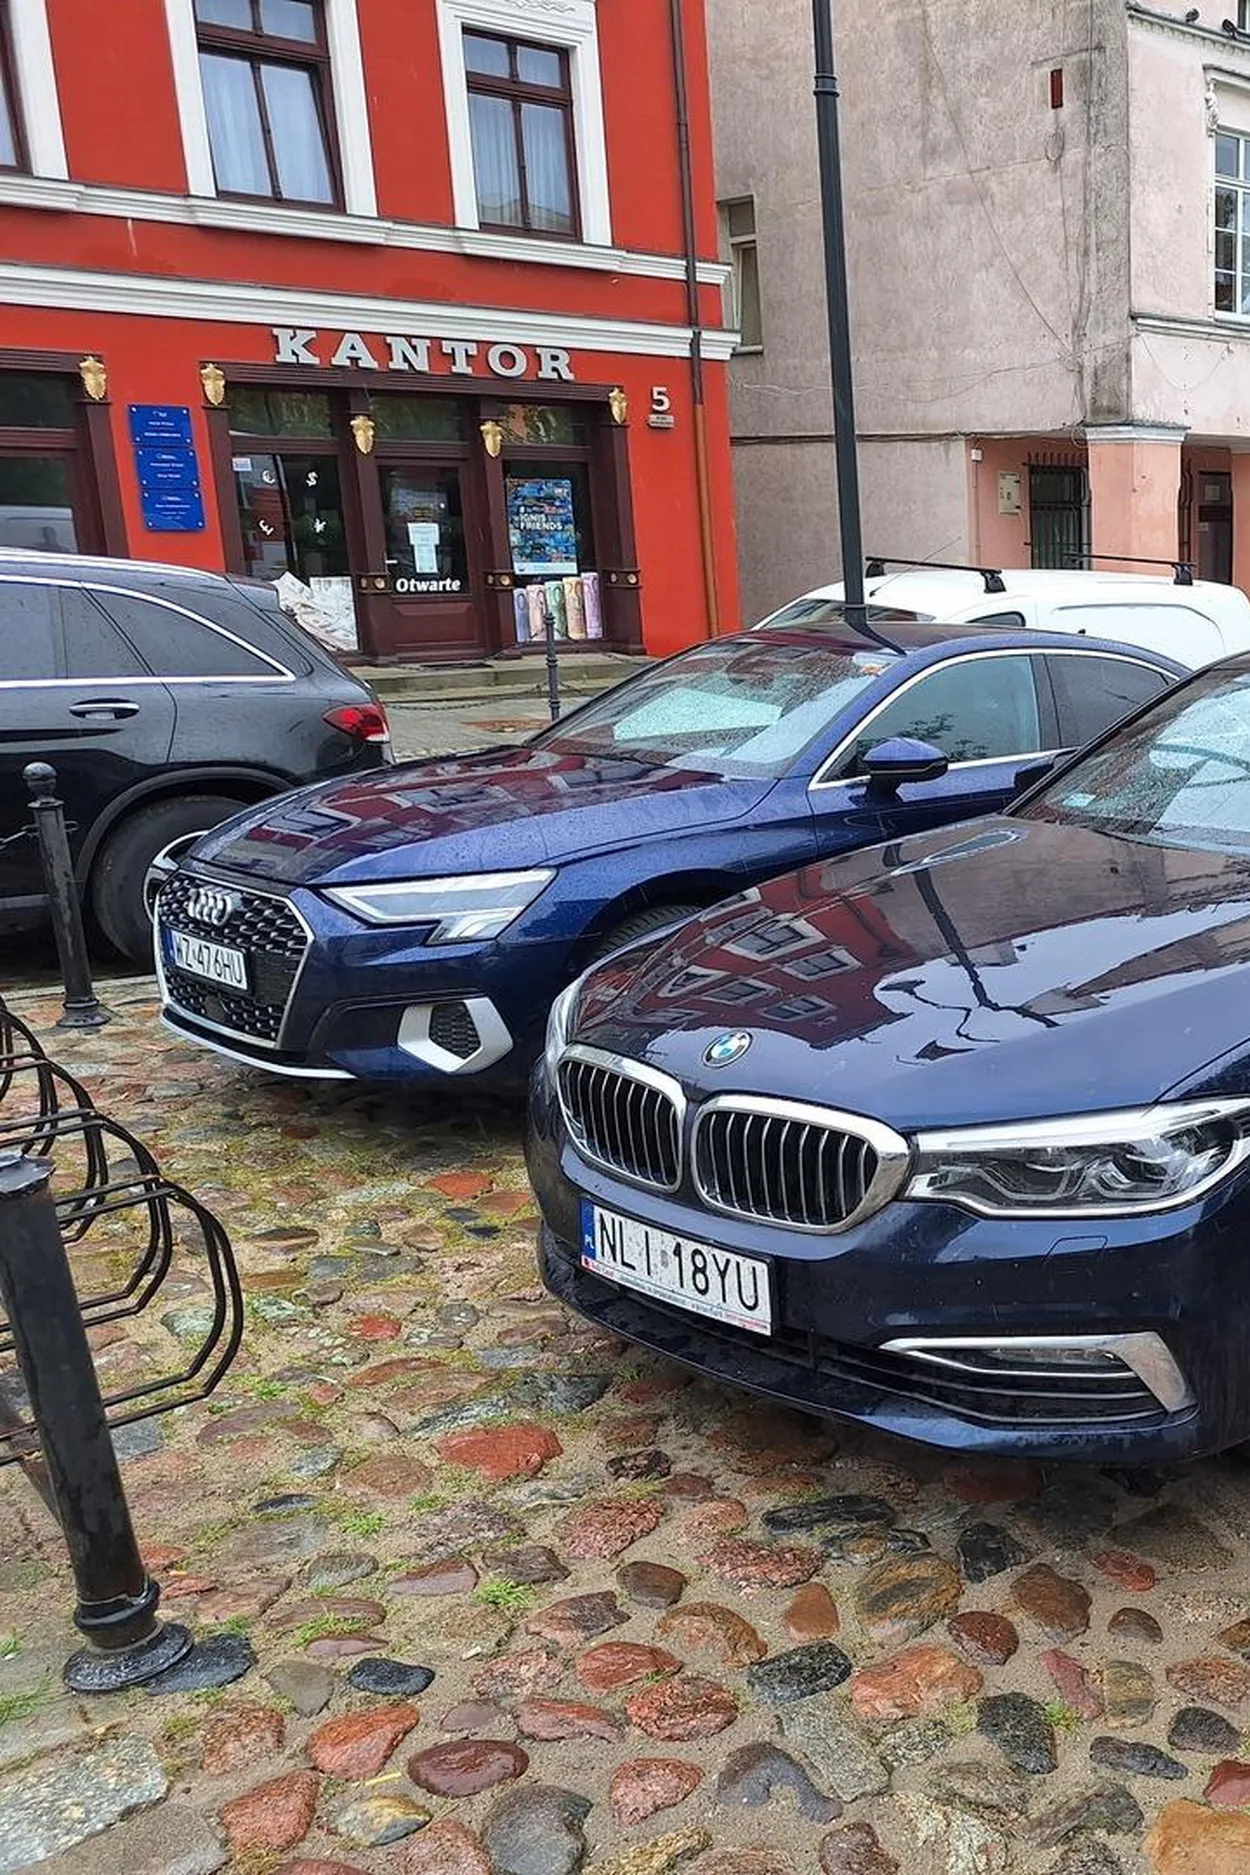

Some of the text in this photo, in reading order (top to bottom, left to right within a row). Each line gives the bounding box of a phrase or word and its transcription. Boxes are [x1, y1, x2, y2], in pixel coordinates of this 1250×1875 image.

[272, 328, 575, 381] KANTOR
[652, 386, 670, 411] 5
[395, 578, 461, 593] Otwarte
[599, 1212, 652, 1277] NLI
[672, 1241, 759, 1312] 18YU
